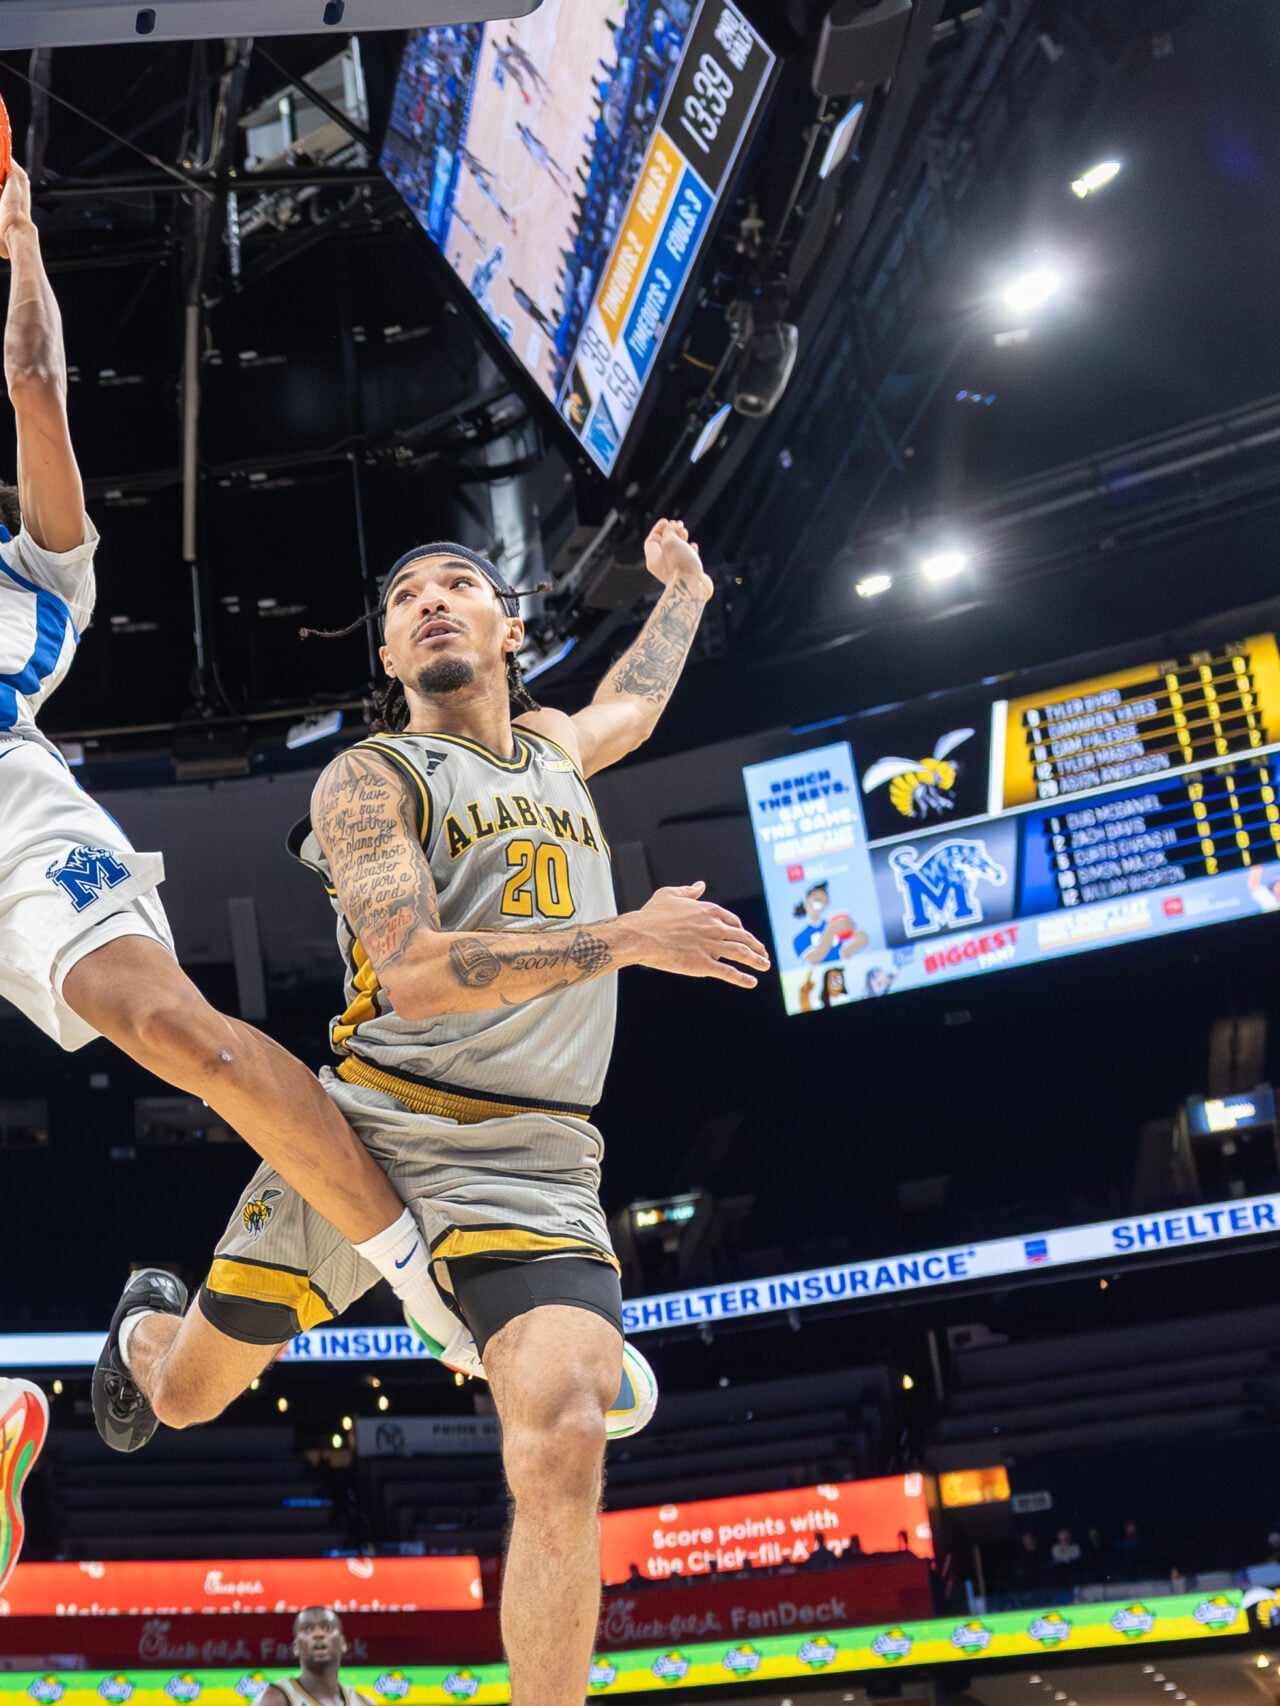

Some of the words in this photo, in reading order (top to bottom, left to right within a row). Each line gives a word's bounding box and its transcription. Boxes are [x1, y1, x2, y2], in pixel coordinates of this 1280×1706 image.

[680, 53, 734, 153] 13:39
[580, 326, 611, 375] 38
[607, 362, 638, 411] 59
[359, 787, 392, 801] have
[758, 795, 792, 812] THE
[779, 798, 828, 822] SAVE
[760, 821, 796, 842] THE
[381, 844, 407, 858] not
[500, 838, 576, 918] 20
[511, 956, 561, 971] 2004
[924, 926, 1020, 974] BIGGEST
[1112, 1203, 1276, 1250] SHELTER
[621, 1287, 760, 1328] SHELTER
[768, 1252, 968, 1307] INSURANCE
[651, 1525, 715, 1550] Score
[718, 1516, 786, 1543] points
[789, 1508, 840, 1533] with
[647, 1554, 684, 1577] the
[730, 1598, 847, 1633] FanDeck
